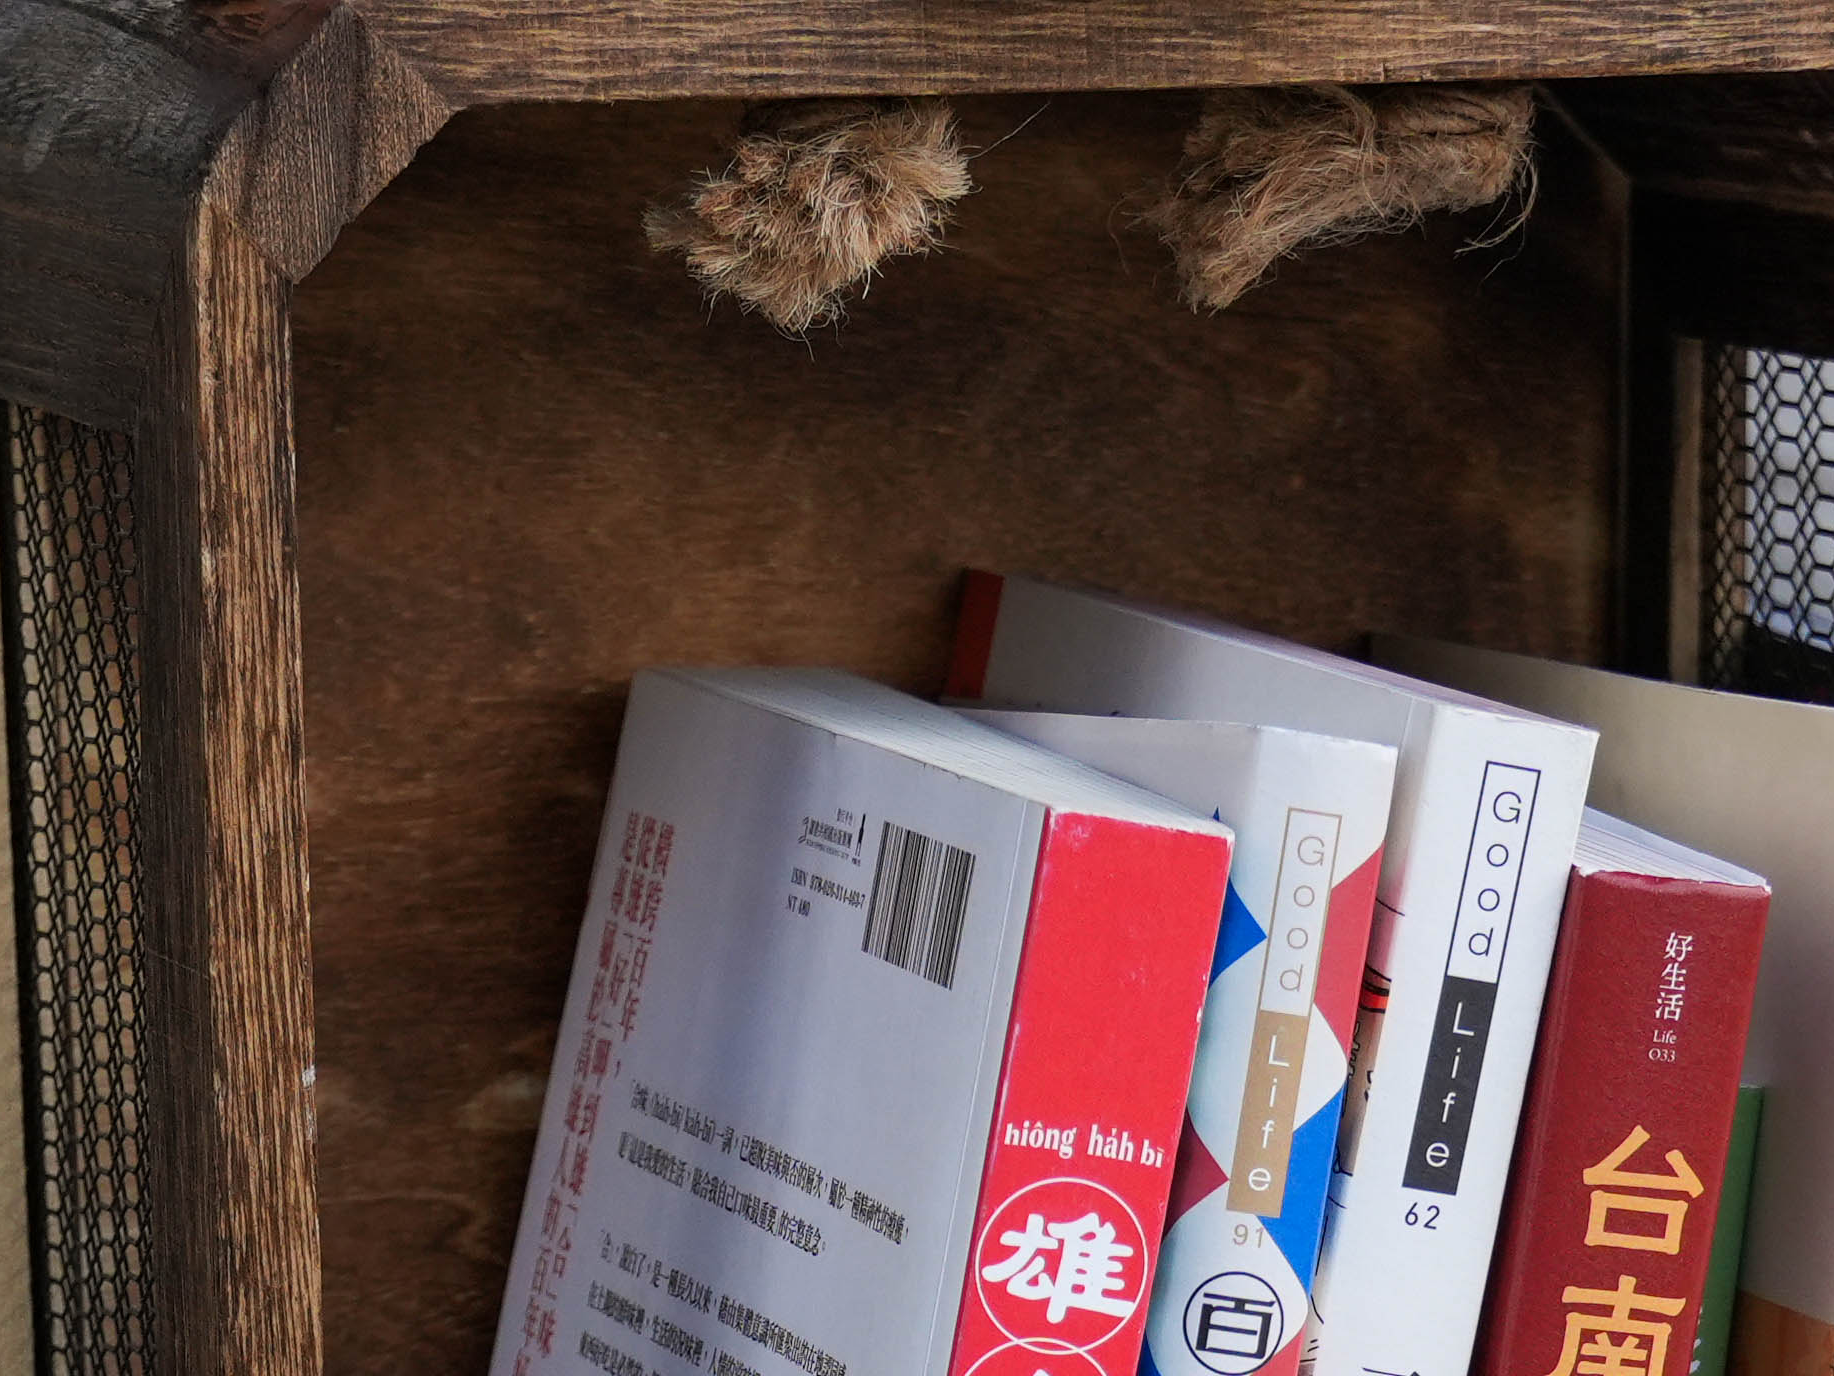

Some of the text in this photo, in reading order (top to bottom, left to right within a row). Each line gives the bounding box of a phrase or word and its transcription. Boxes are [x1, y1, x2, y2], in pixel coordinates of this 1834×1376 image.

[1655, 932, 1695, 1022] 好生活
[1652, 1029, 1678, 1044] Life
[1403, 1203, 1442, 1231] 62
[1232, 1223, 1266, 1248] 91
